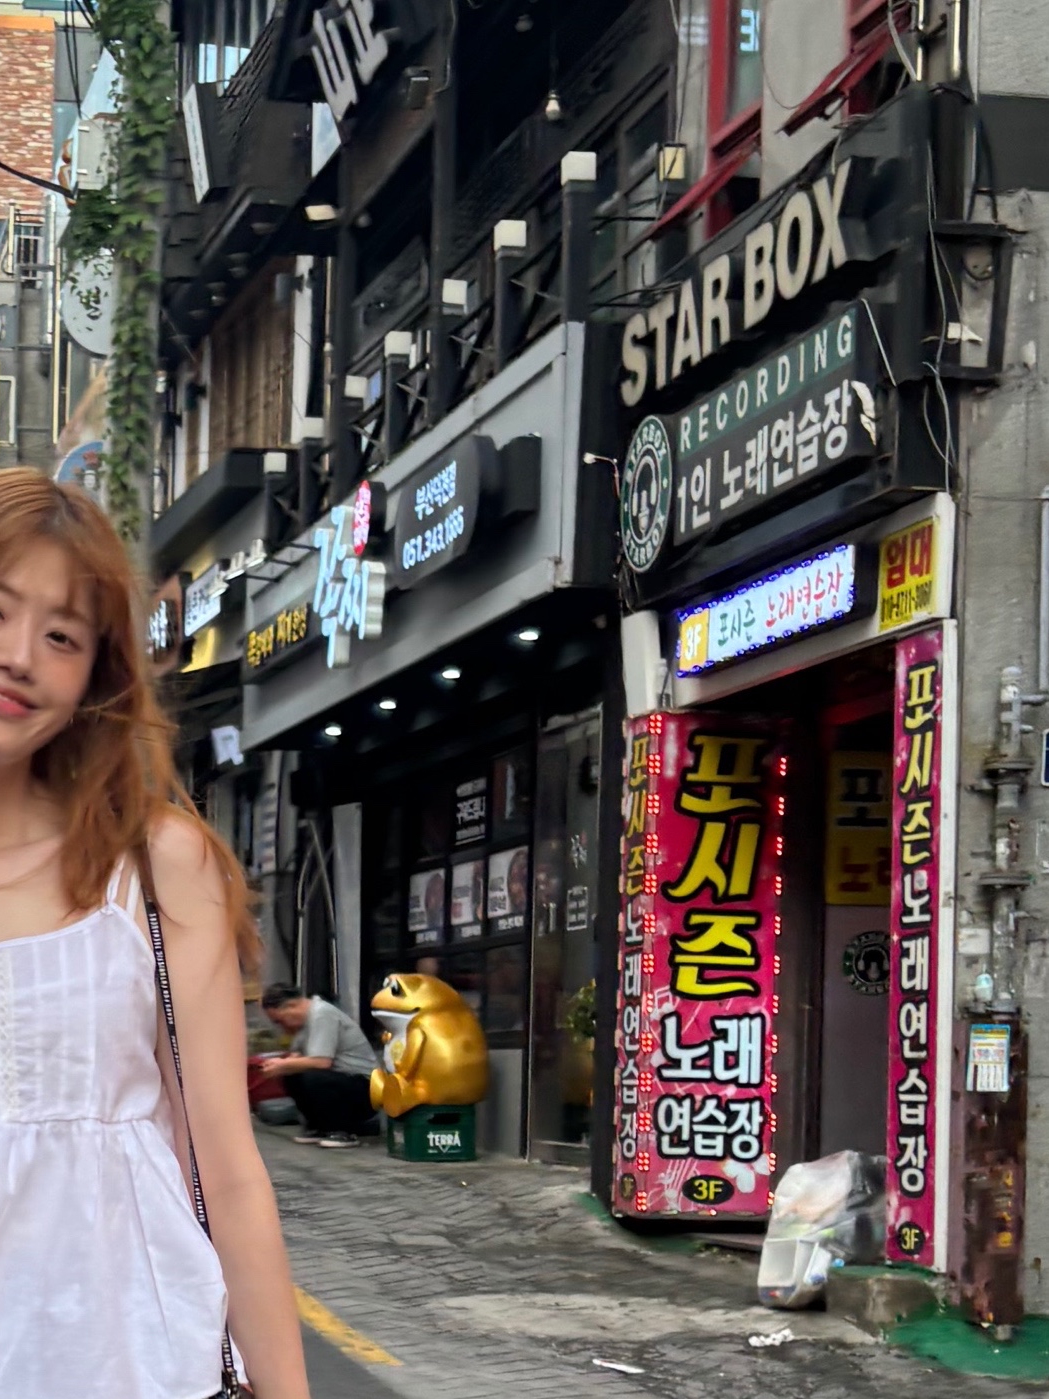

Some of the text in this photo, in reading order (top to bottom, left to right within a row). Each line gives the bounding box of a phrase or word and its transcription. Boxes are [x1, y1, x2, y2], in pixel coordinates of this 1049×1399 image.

[621, 158, 851, 408] STAR BOX
[679, 314, 853, 453] RECORDING
[677, 379, 853, 533] 1인 노래연습장
[717, 598, 756, 647] 포시즌
[765, 562, 844, 628] 노래연습장
[885, 524, 934, 590] 임대
[626, 737, 649, 895] 포시즌
[662, 735, 768, 996] 포시즌
[895, 664, 938, 1193] 포시즌 노래연습장
[660, 1015, 763, 1085] 노래
[656, 1097, 764, 1161] 연습장
[692, 1179, 724, 1201] 3F
[900, 1227, 920, 1250] 3F
